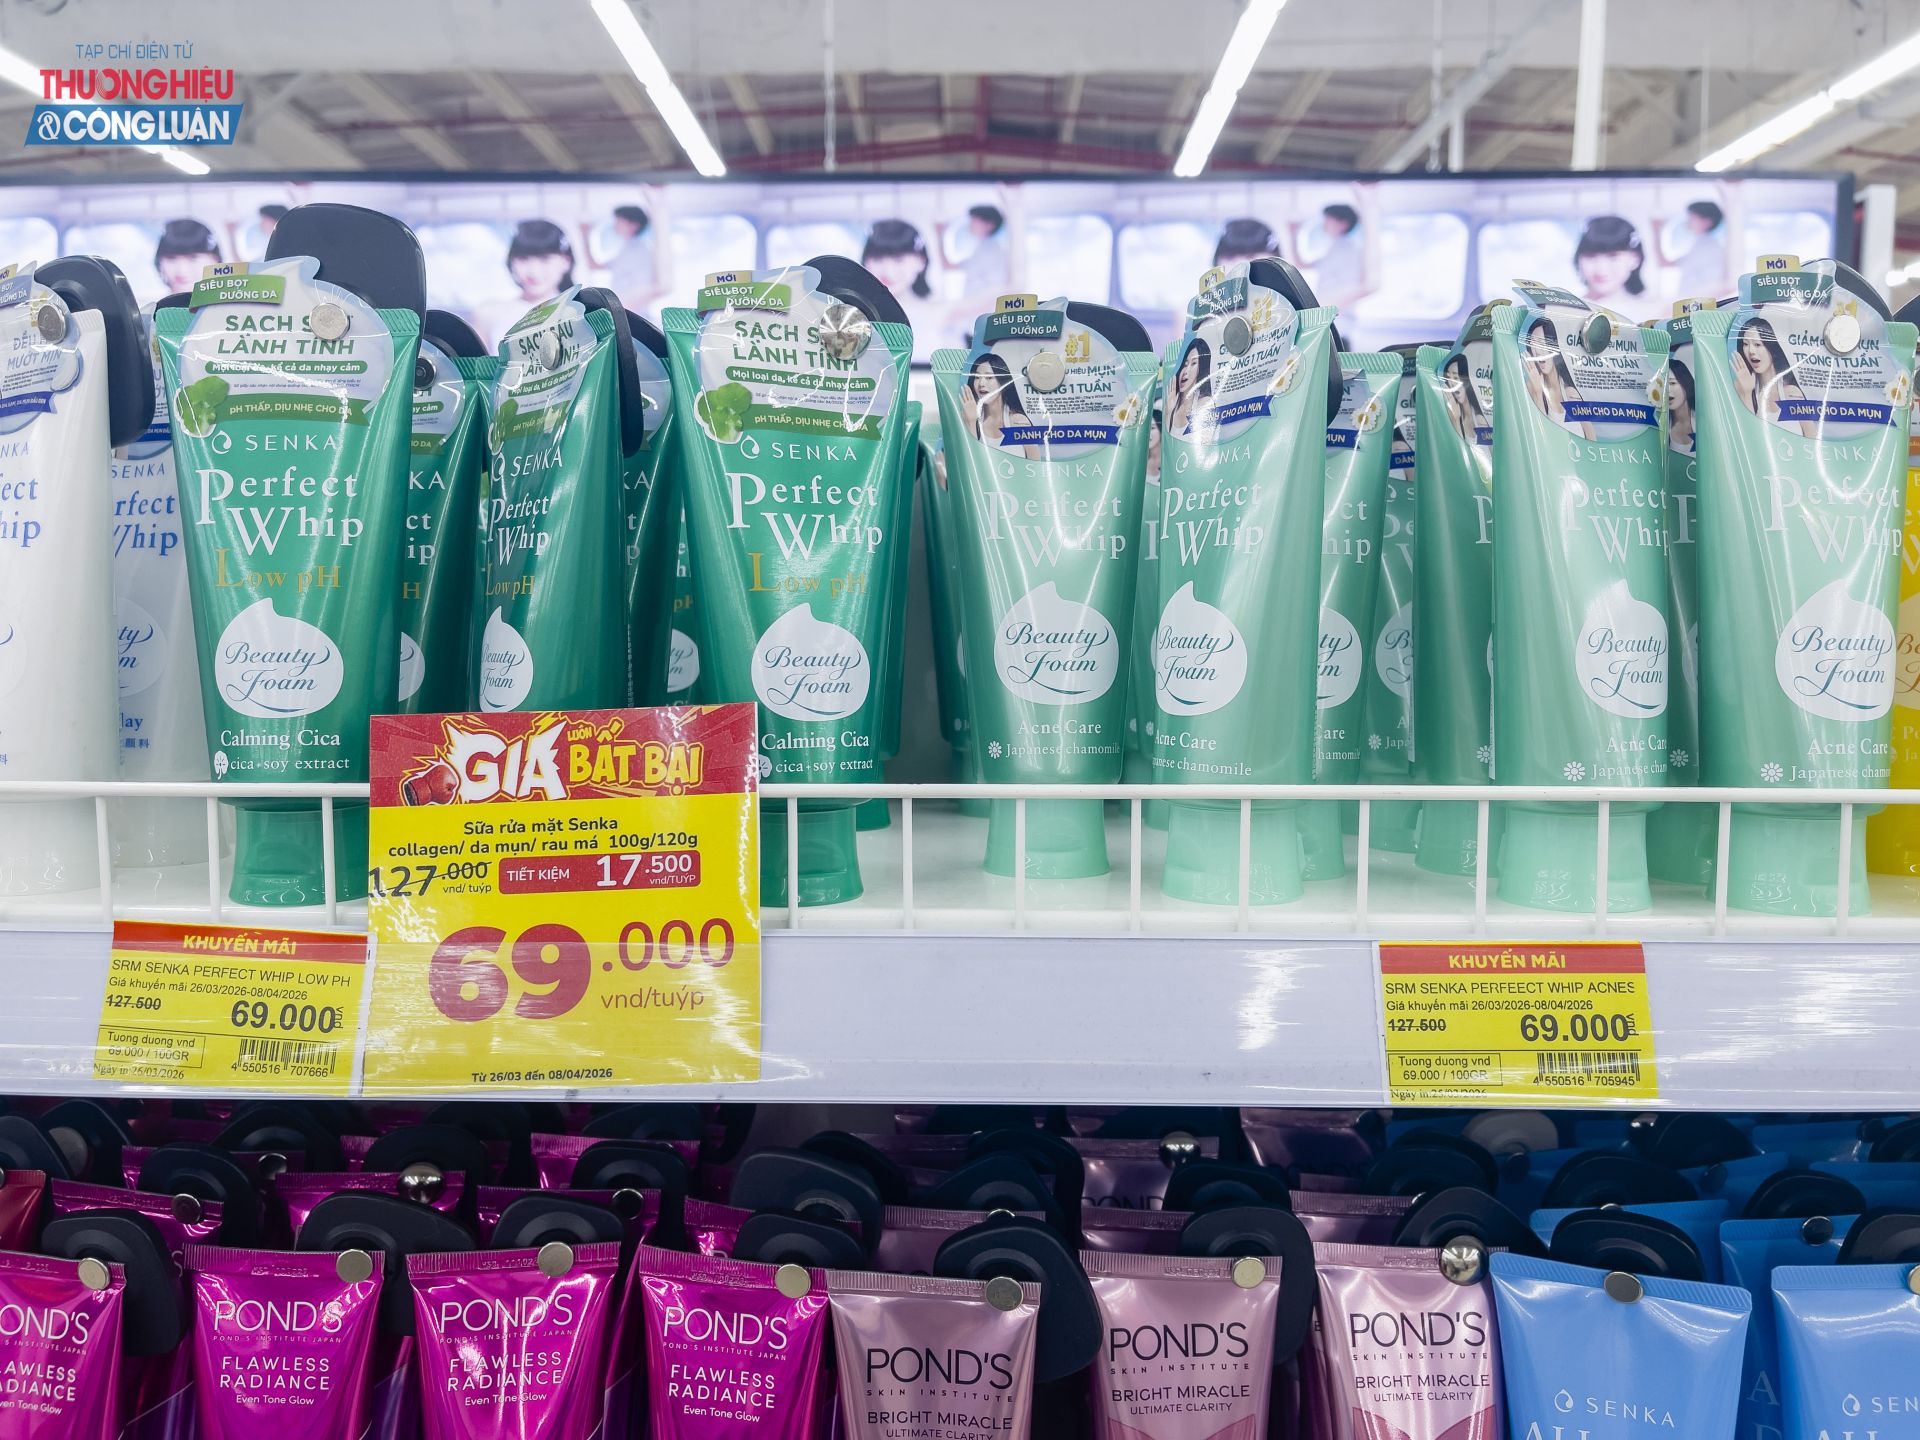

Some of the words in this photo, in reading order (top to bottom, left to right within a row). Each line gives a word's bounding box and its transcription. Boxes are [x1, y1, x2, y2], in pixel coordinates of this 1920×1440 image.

[213, 265, 233, 275] MỚI
[1766, 259, 1787, 269] MỚI
[199, 279, 224, 291] SIÊU
[226, 278, 249, 290] BỌT
[716, 273, 737, 283] MỚI
[1757, 275, 1778, 286] SIÊU
[1781, 276, 1800, 287] BỌT
[219, 288, 260, 301] DƯỠNG
[261, 289, 278, 300] DA
[1004, 299, 1025, 309] MỚI
[225, 314, 294, 334] SẠCH
[993, 314, 1015, 326] SIÊU
[1017, 314, 1036, 325] BỌT
[1011, 323, 1044, 336] DƯỠNG
[1046, 325, 1058, 334] DA
[734, 320, 799, 343] SẠCH
[217, 332, 287, 355] LÀNH
[284, 360, 296, 372] cả
[313, 362, 337, 374] nhạy
[339, 360, 361, 372] cảm
[732, 369, 750, 380] Mọi
[752, 371, 770, 382] loại
[1079, 374, 1112, 393] TUẦN
[244, 400, 272, 413] THẤP,
[274, 402, 289, 414] DỊU
[290, 403, 313, 414] NHẸ
[315, 404, 336, 414] CHO
[1592, 406, 1607, 417] CHO
[1608, 407, 1625, 417] DA
[1626, 408, 1647, 420] MỤN
[1858, 408, 1882, 420] MỤN
[245, 434, 338, 451] SENKA
[1013, 429, 1041, 441] DÀNH
[1067, 430, 1081, 439] DA
[1084, 430, 1107, 442] MỤN
[510, 446, 563, 477] SENKA
[771, 442, 857, 461] SENKA
[1588, 446, 1651, 464] SENKA
[195, 465, 358, 525] Perfect
[724, 470, 878, 530] Perfect
[487, 491, 549, 543] Perfect
[1160, 478, 1262, 540] Perfect
[226, 505, 364, 556] Whip
[760, 512, 883, 562] Whip
[496, 521, 550, 566] Whip
[1175, 516, 1264, 567] Whip
[215, 548, 288, 588] Low
[297, 565, 342, 592] pH
[1006, 621, 1110, 658] Beauty
[1158, 625, 1235, 665] Beauty
[225, 641, 331, 677] Beauty
[765, 645, 862, 680] Beauty
[1007, 650, 1099, 695] Foam
[225, 668, 318, 713] Foam
[766, 673, 852, 716] Foam
[567, 726, 592, 742] LUÔN
[1018, 719, 1061, 735] Acne
[1063, 719, 1102, 735] Care
[221, 729, 290, 749] Calming
[297, 728, 341, 746] Cica
[761, 732, 836, 751] Calming
[840, 731, 870, 748] Cica
[1180, 733, 1217, 751] Care
[446, 721, 567, 801] GIÁ
[568, 717, 637, 785] BẤT
[295, 757, 350, 769] extract
[644, 742, 701, 796] BẠI
[464, 820, 494, 836] Sữa
[499, 818, 527, 835] rửa
[532, 817, 565, 835] mặt
[568, 816, 618, 832] Senka
[388, 842, 465, 859] collagen/
[470, 840, 490, 855] da
[494, 838, 537, 857] mụn/
[542, 839, 569, 852] rau
[574, 836, 599, 851] má
[608, 832, 698, 852] 100g/120g
[506, 866, 536, 883] TIẾT
[538, 866, 570, 884] KIỆM
[183, 932, 259, 954] KHUYẾN
[262, 937, 297, 956] MÃI
[1449, 948, 1526, 969] KHUYẾN
[1531, 951, 1566, 969] MÃI
[111, 959, 142, 973] SRM
[144, 961, 190, 977] SENKA
[193, 965, 256, 981] PERFECT
[259, 969, 295, 985] WHIP
[297, 973, 329, 986] LOW
[331, 974, 351, 987] PH
[108, 976, 127, 988] Giá
[128, 976, 166, 992] khuyến
[168, 979, 187, 993] mãi
[189, 981, 308, 1001] 26/03/2026-08/04/2026
[601, 984, 705, 1010] vnd/tuýp
[1385, 982, 1416, 995] SRM
[1420, 982, 1467, 995] SENKA
[1470, 981, 1544, 995] PERFEECT
[1547, 981, 1584, 994] WHIP
[1588, 981, 1635, 994] ACNES
[106, 993, 162, 1011] 127.500
[231, 999, 336, 1034] 69.000
[1386, 999, 1406, 1012] Giá
[1408, 998, 1447, 1013] khuyến
[1449, 1000, 1469, 1011] mãi
[1471, 999, 1593, 1012] 26/03/2026-08/04/2026
[1388, 1018, 1447, 1032] 127.500
[1520, 1013, 1630, 1042] 69.000
[242, 1063, 281, 1075] 550516
[290, 1065, 328, 1078] 707666
[1398, 1056, 1432, 1069] Tuong
[1435, 1055, 1465, 1069] duong
[1468, 1055, 1491, 1067] vnd
[471, 1071, 488, 1083] Từ
[489, 1070, 521, 1083] 26/03
[524, 1069, 546, 1082] đến
[548, 1068, 613, 1081] 08/04/2026
[1545, 1075, 1585, 1086] 550516
[1595, 1075, 1636, 1086] 705945
[213, 1300, 343, 1333] POND'S
[439, 1293, 573, 1334] POND'S
[662, 1305, 789, 1350] POND'S
[1110, 1322, 1249, 1362] POND'S
[221, 1356, 330, 1372] FLAWLESS
[866, 1346, 1013, 1390] POND'S
[219, 1374, 330, 1391] RADIANCE
[670, 1364, 776, 1389] FLAWLESS
[236, 1394, 260, 1405] Even
[263, 1394, 286, 1405] Tone
[288, 1395, 315, 1406] Glow
[668, 1382, 776, 1409] RADIANCE
[1112, 1386, 1174, 1402] BRIGHT
[1177, 1384, 1250, 1400] MIRACLE
[1129, 1403, 1183, 1416] ULTIMATE
[1185, 1402, 1232, 1413] CLARITY
[1586, 1397, 1675, 1429] SENKA
[867, 1410, 932, 1426] BRIGHT
[937, 1412, 1013, 1430] MIRACLE
